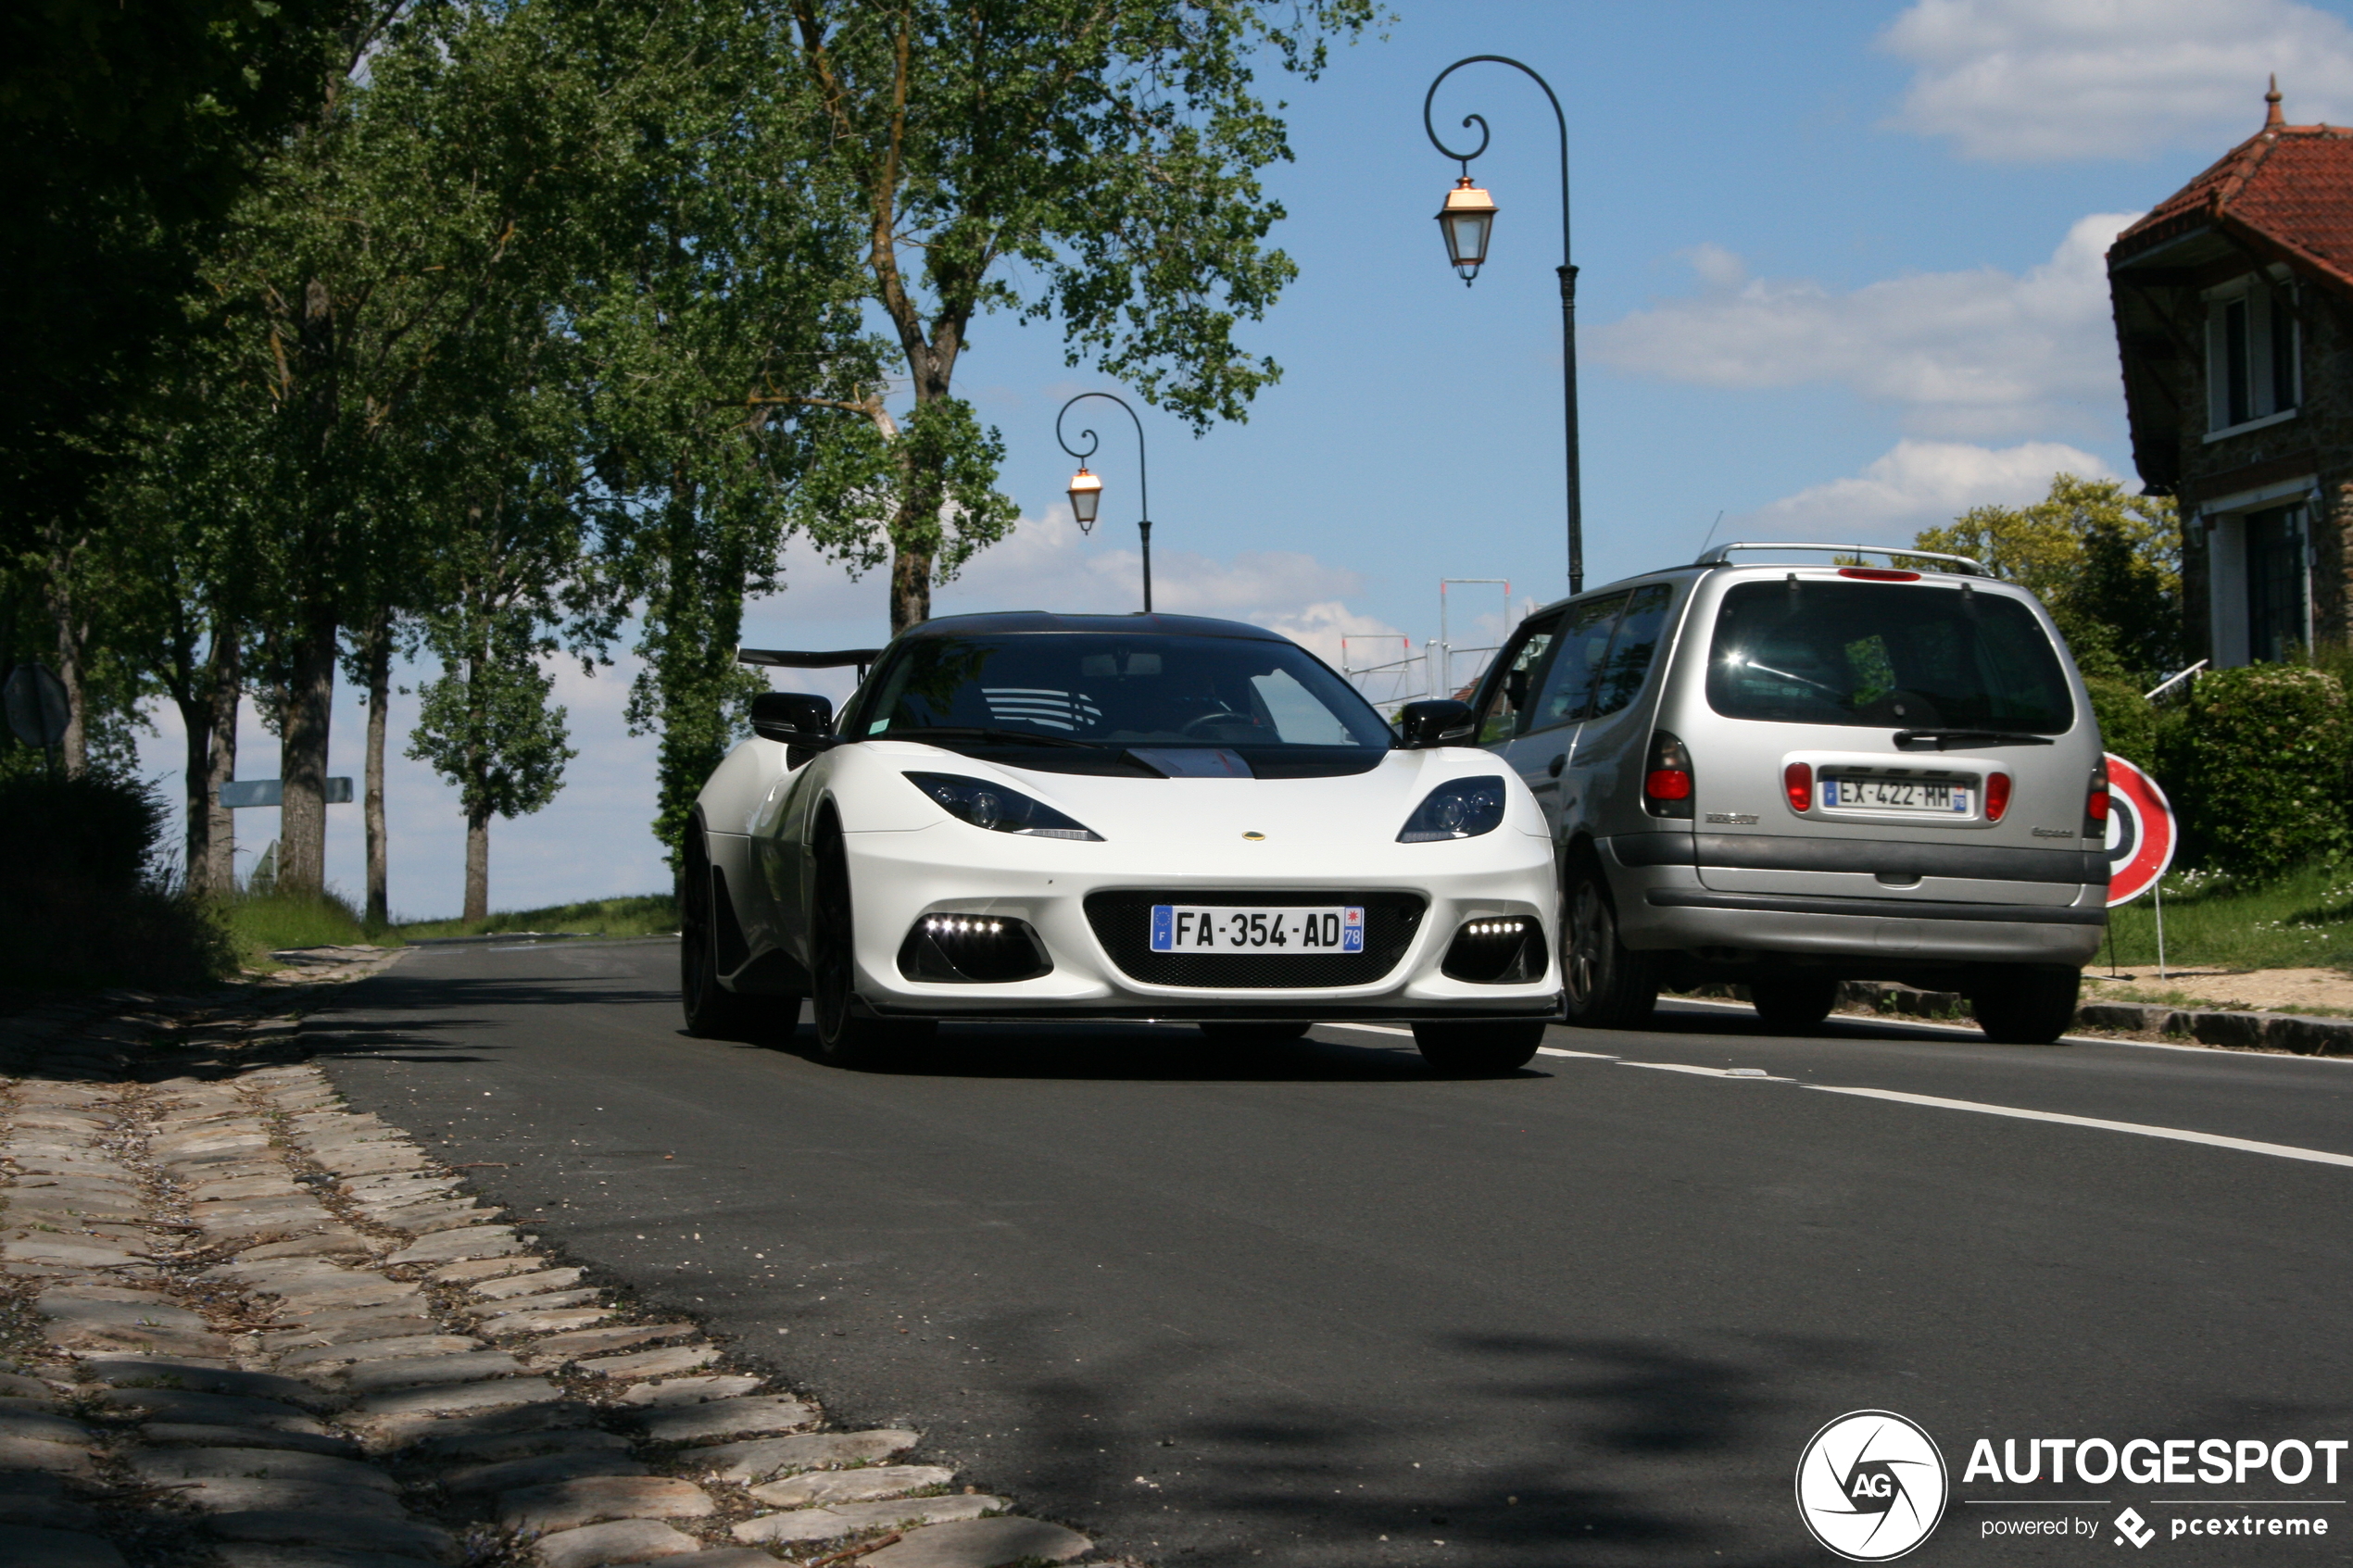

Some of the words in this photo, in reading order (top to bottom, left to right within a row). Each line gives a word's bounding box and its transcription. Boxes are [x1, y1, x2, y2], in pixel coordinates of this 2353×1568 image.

[1159, 932, 1166, 941] F
[1176, 912, 1340, 947] FA-354-AD
[1344, 929, 1361, 945] 78
